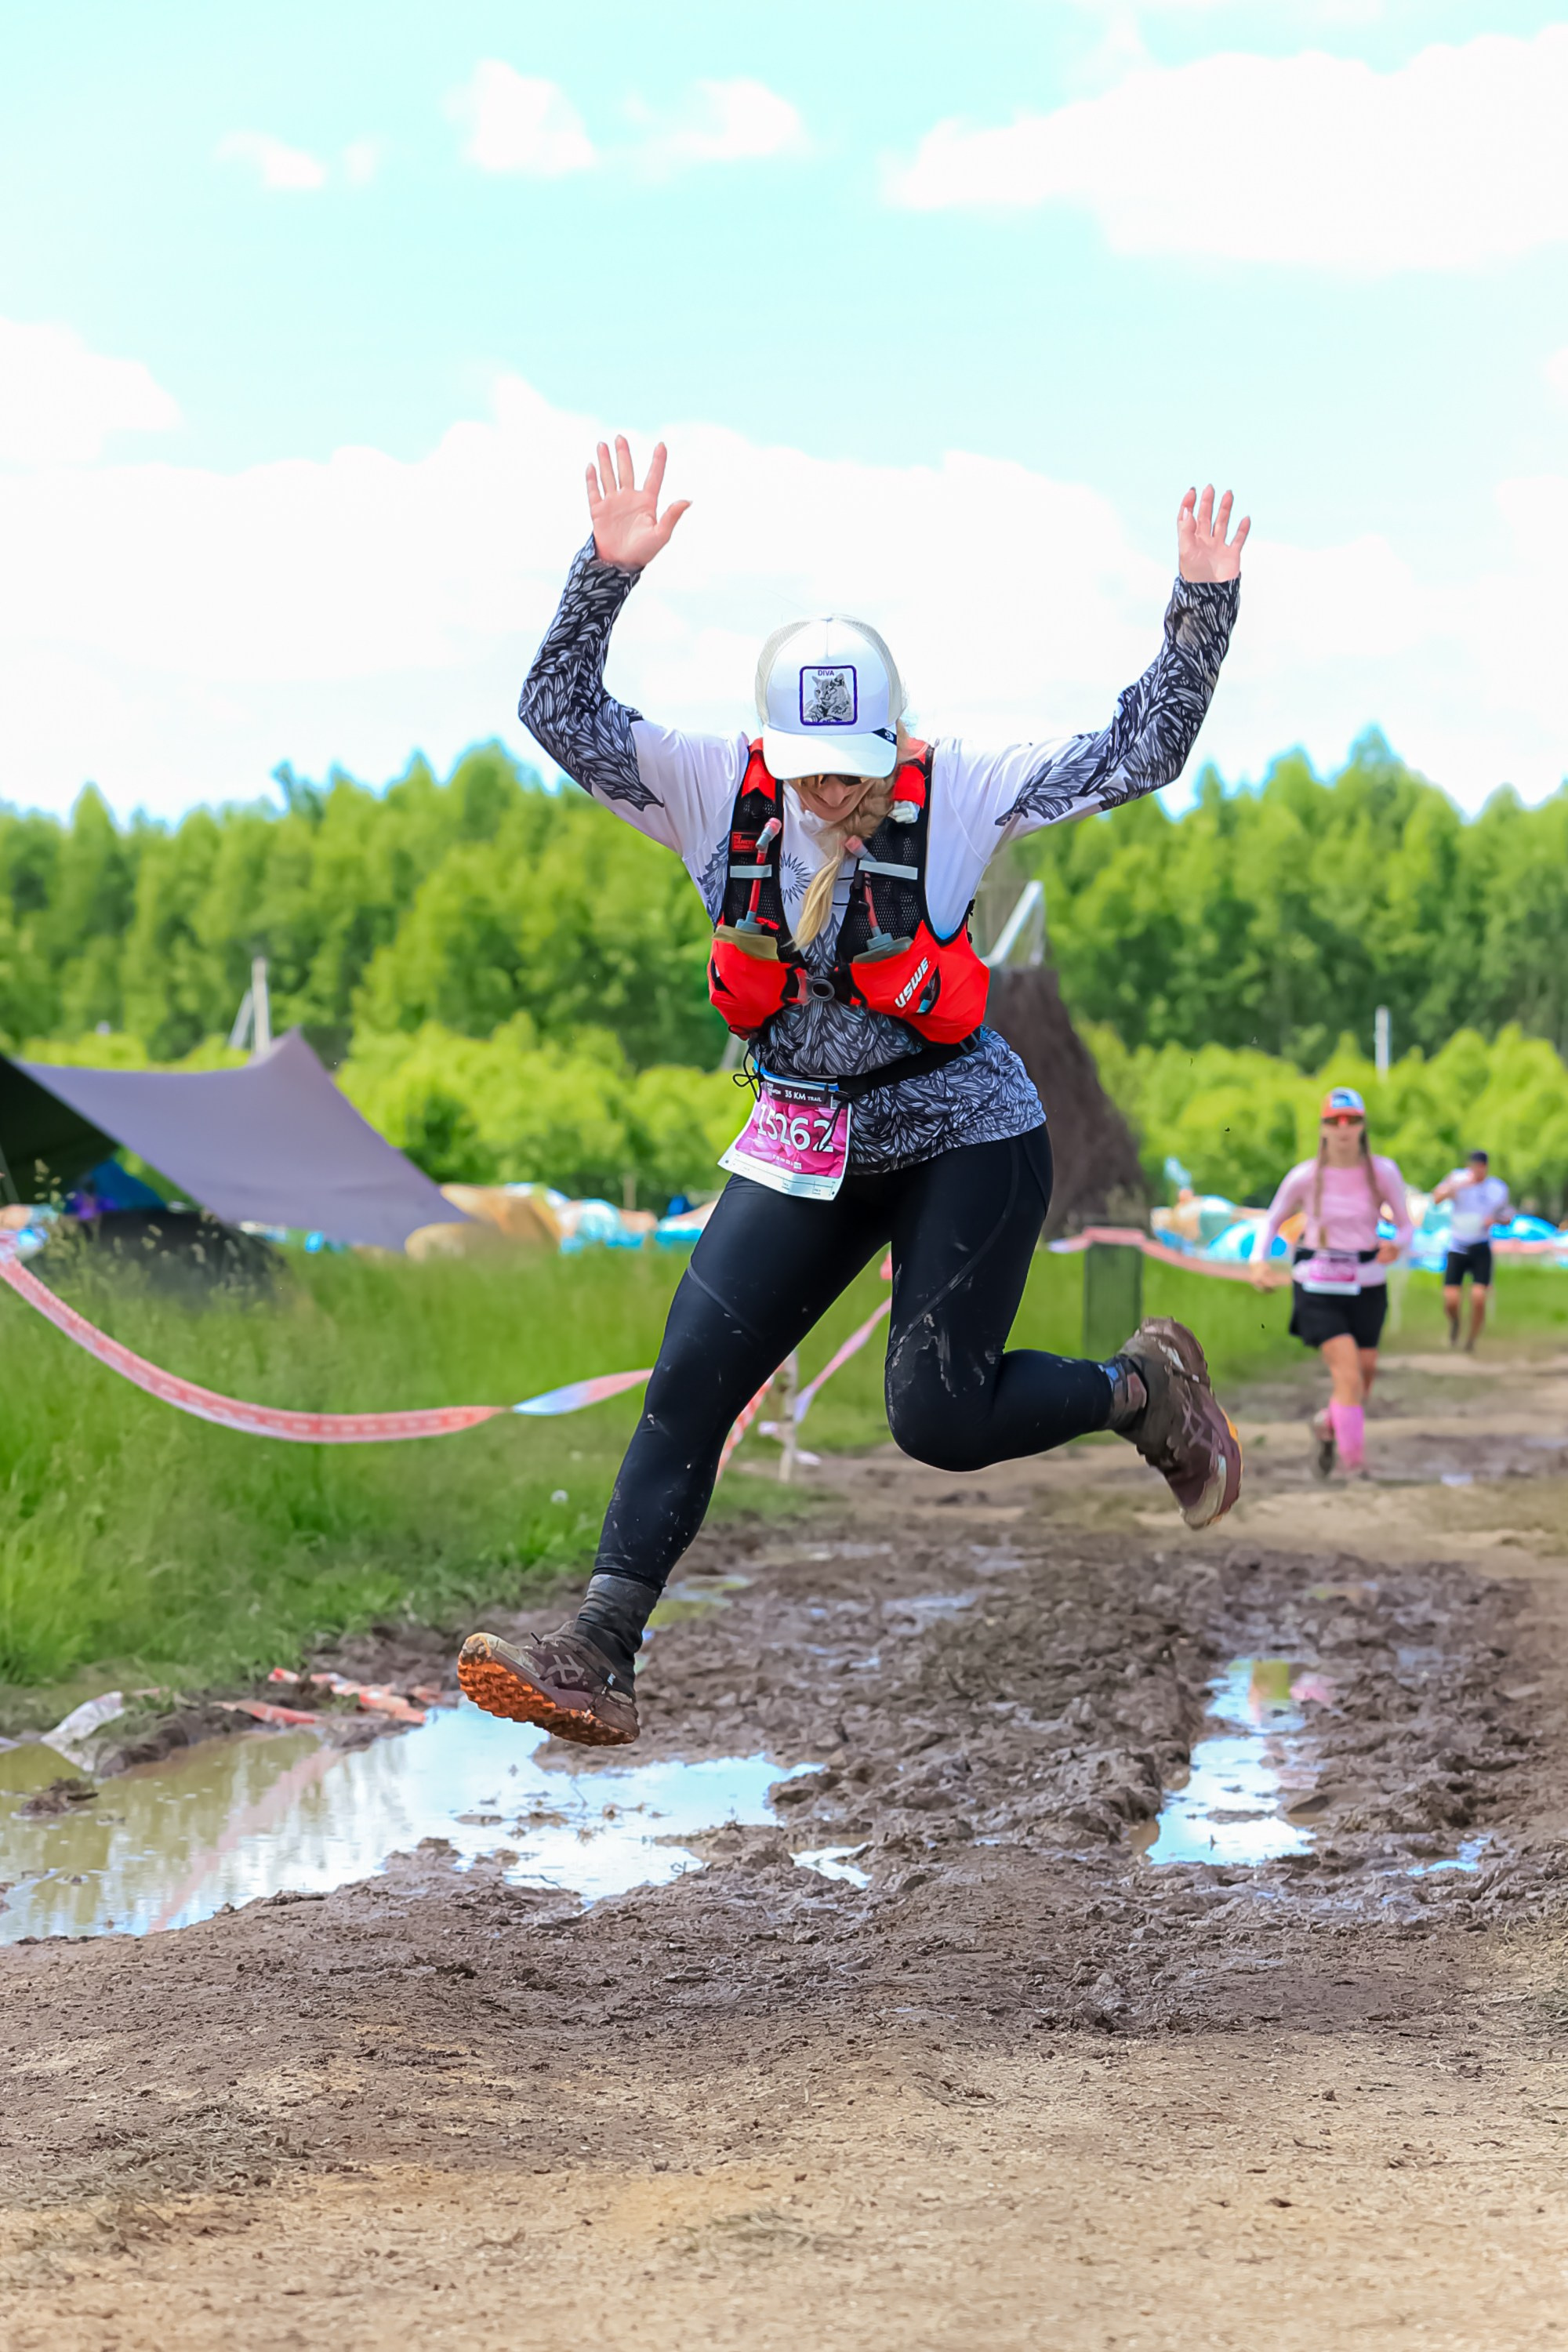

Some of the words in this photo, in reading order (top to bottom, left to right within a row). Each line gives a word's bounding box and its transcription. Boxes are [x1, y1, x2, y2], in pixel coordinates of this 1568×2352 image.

[895, 956, 928, 1008] USWE
[785, 1089, 793, 1098] 35
[793, 1091, 806, 1101] KM
[758, 1104, 833, 1152] 15262
